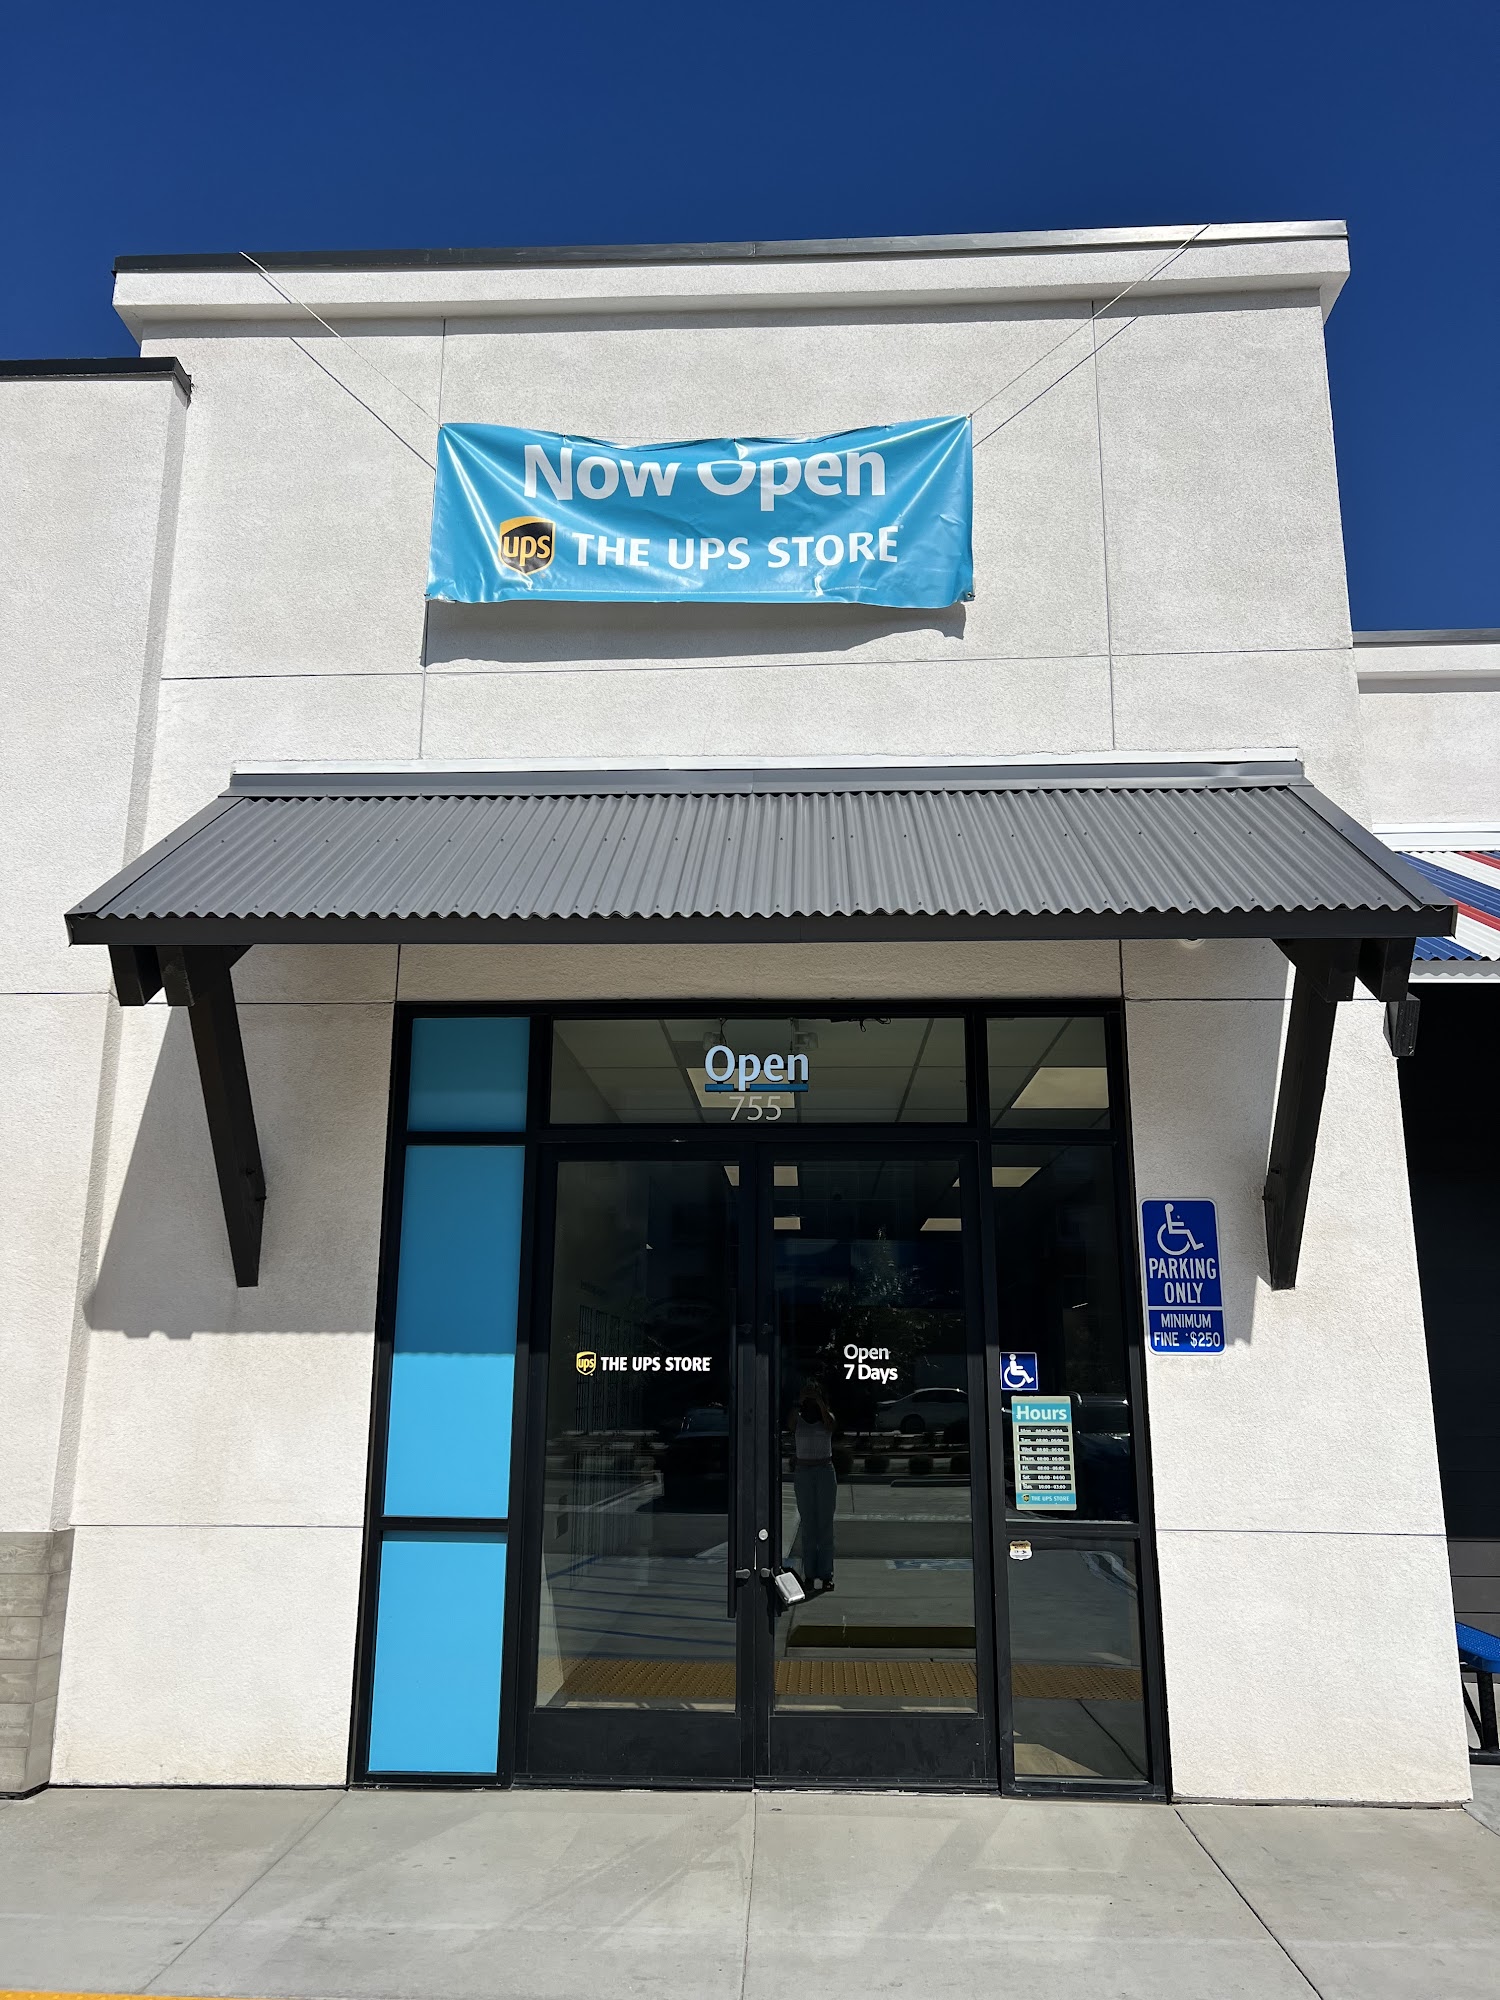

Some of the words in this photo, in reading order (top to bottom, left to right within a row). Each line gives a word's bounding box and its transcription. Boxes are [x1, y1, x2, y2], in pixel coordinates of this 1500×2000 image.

[524, 444, 682, 501] Now
[697, 452, 886, 512] Open
[503, 535, 551, 567] ups
[571, 532, 650, 567] THE
[667, 537, 751, 571] UPS
[767, 525, 899, 569] STORE
[705, 1045, 809, 1092] Open
[729, 1095, 782, 1121] 755
[1148, 1257, 1217, 1280] PARKING
[1163, 1281, 1203, 1304] ONLY
[1160, 1313, 1212, 1329] MINIMUM
[1153, 1331, 1180, 1347] FINE
[1189, 1331, 1221, 1348] $250
[600, 1356, 628, 1372] THE
[632, 1356, 661, 1372] UPS
[665, 1356, 711, 1372] STORE
[843, 1343, 890, 1364] Open
[577, 1358, 595, 1372] ups
[843, 1363, 855, 1380] 7
[858, 1363, 899, 1385] Days
[1016, 1405, 1068, 1420] Hours
